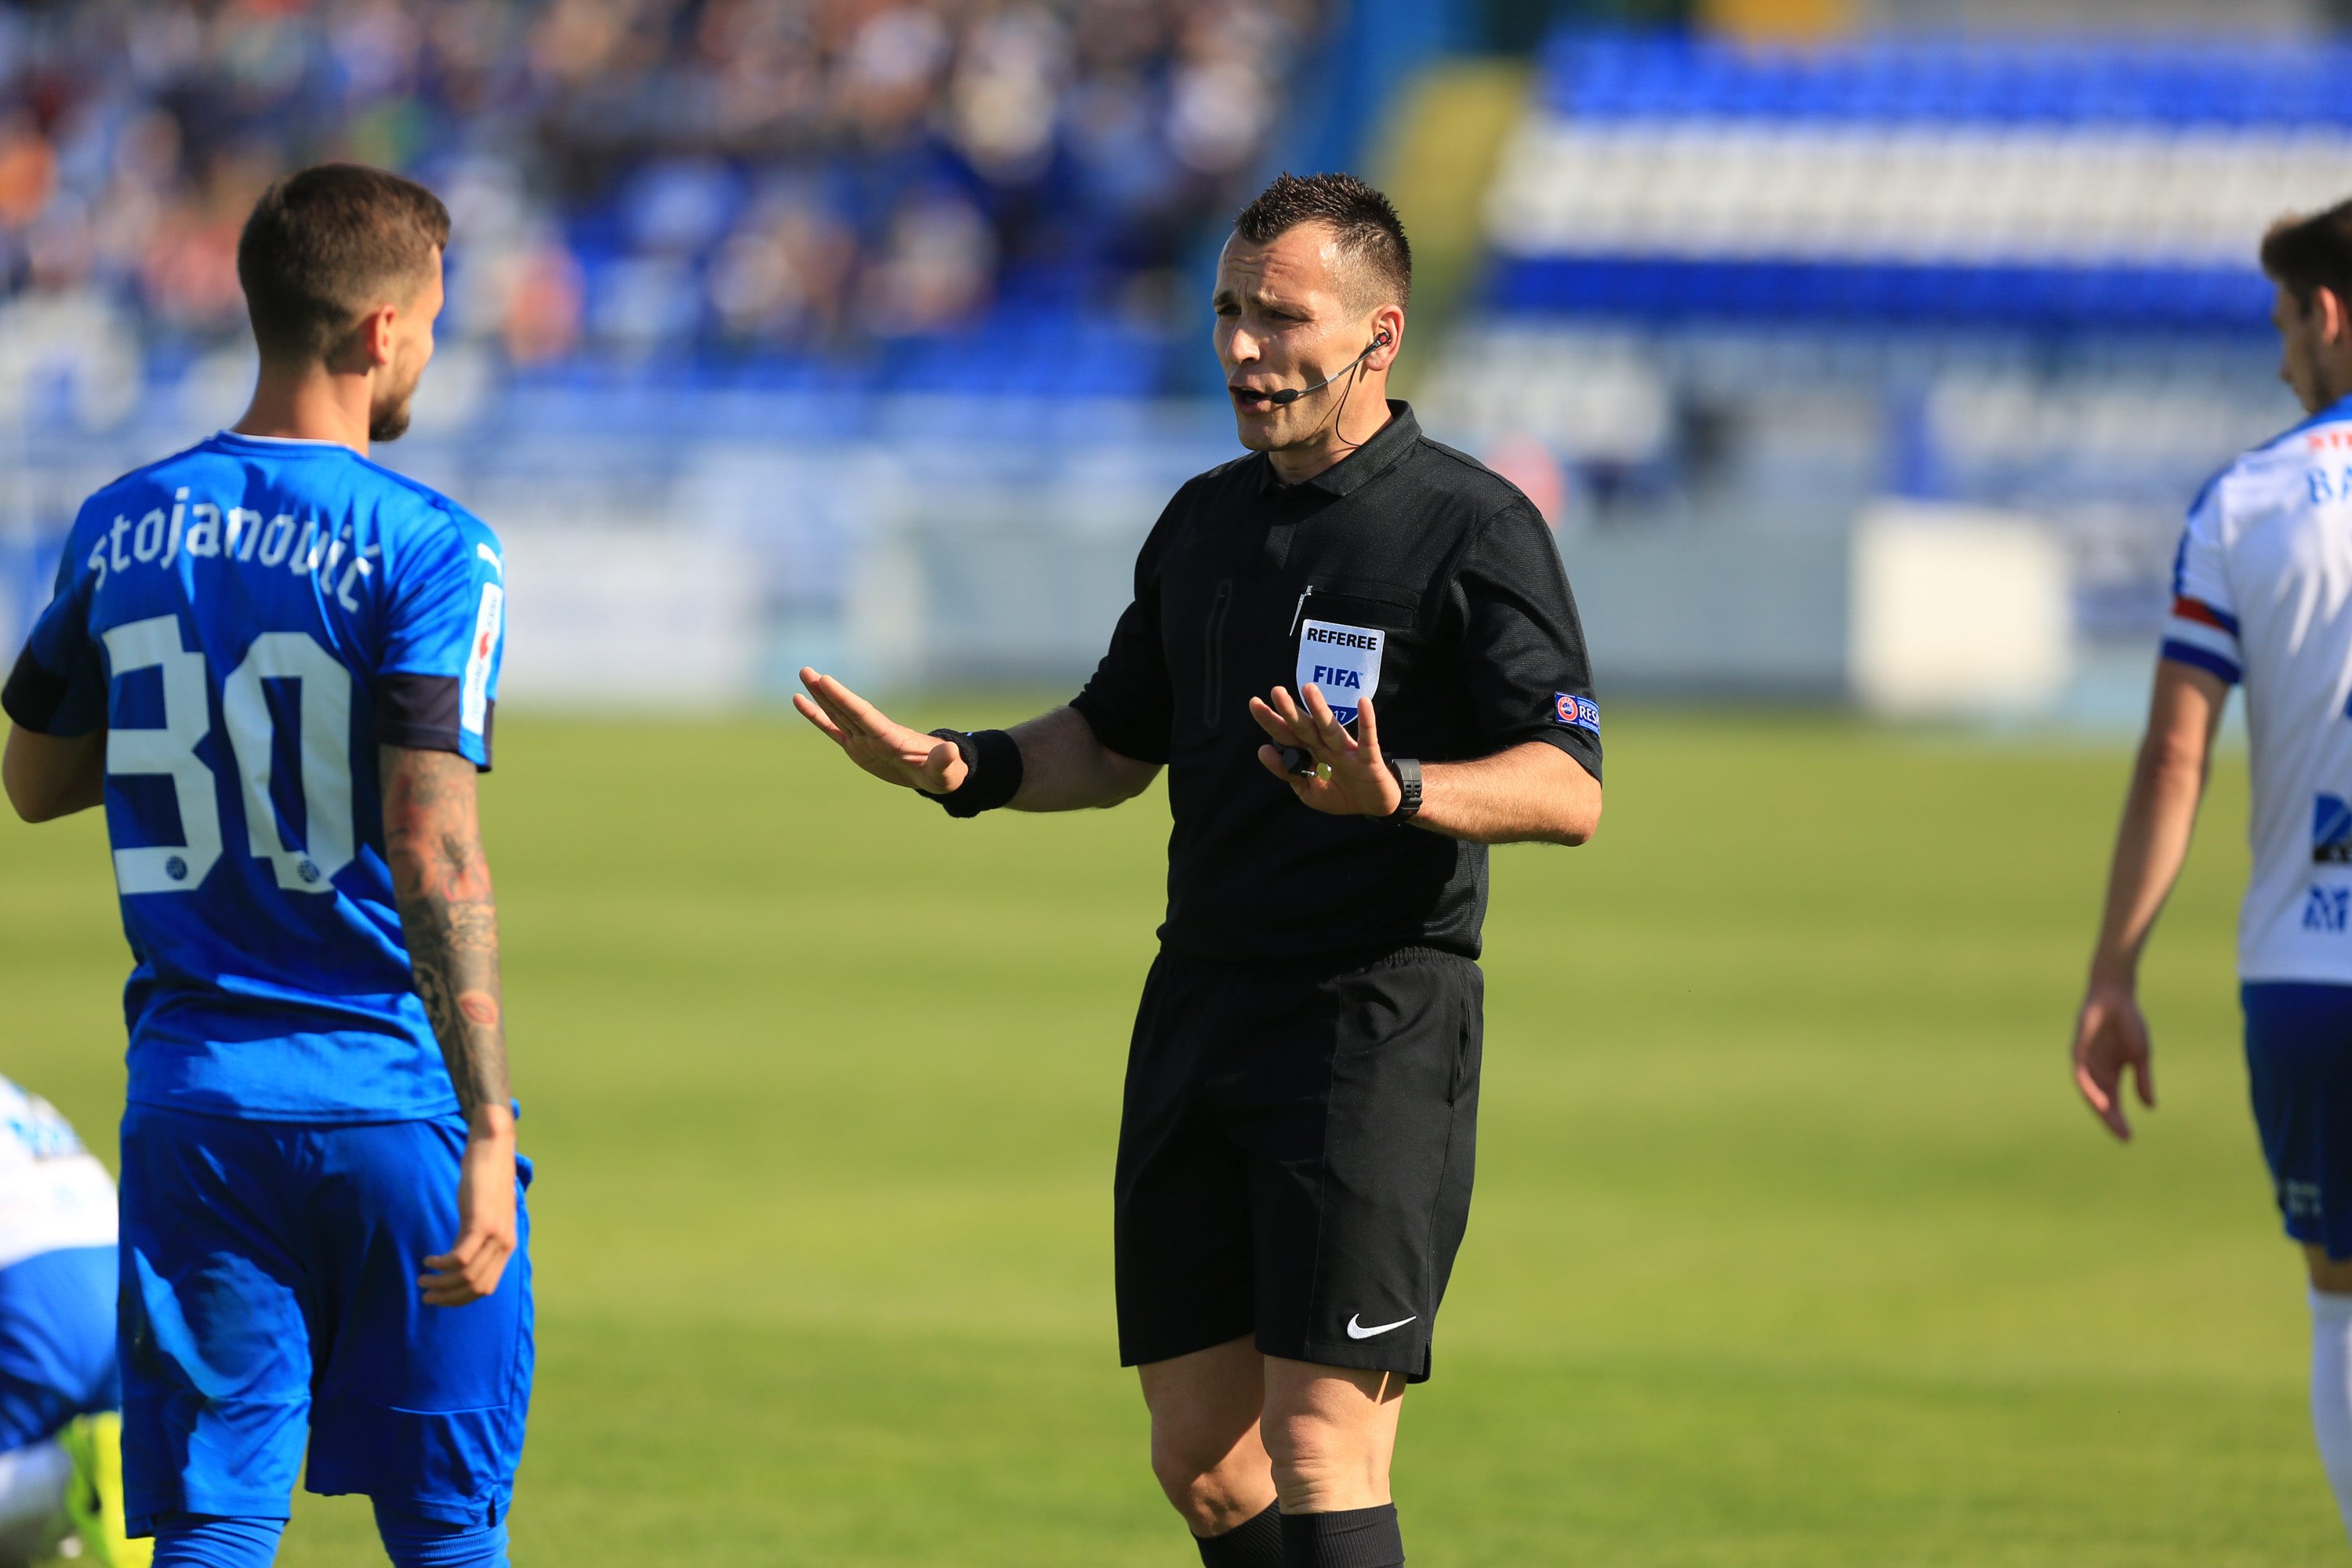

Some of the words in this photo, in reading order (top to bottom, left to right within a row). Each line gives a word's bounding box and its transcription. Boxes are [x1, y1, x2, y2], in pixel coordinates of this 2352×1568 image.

[1307, 627, 1377, 650] REFEREE
[1313, 665, 1360, 689] FIFA
[101, 614, 354, 894] 30
